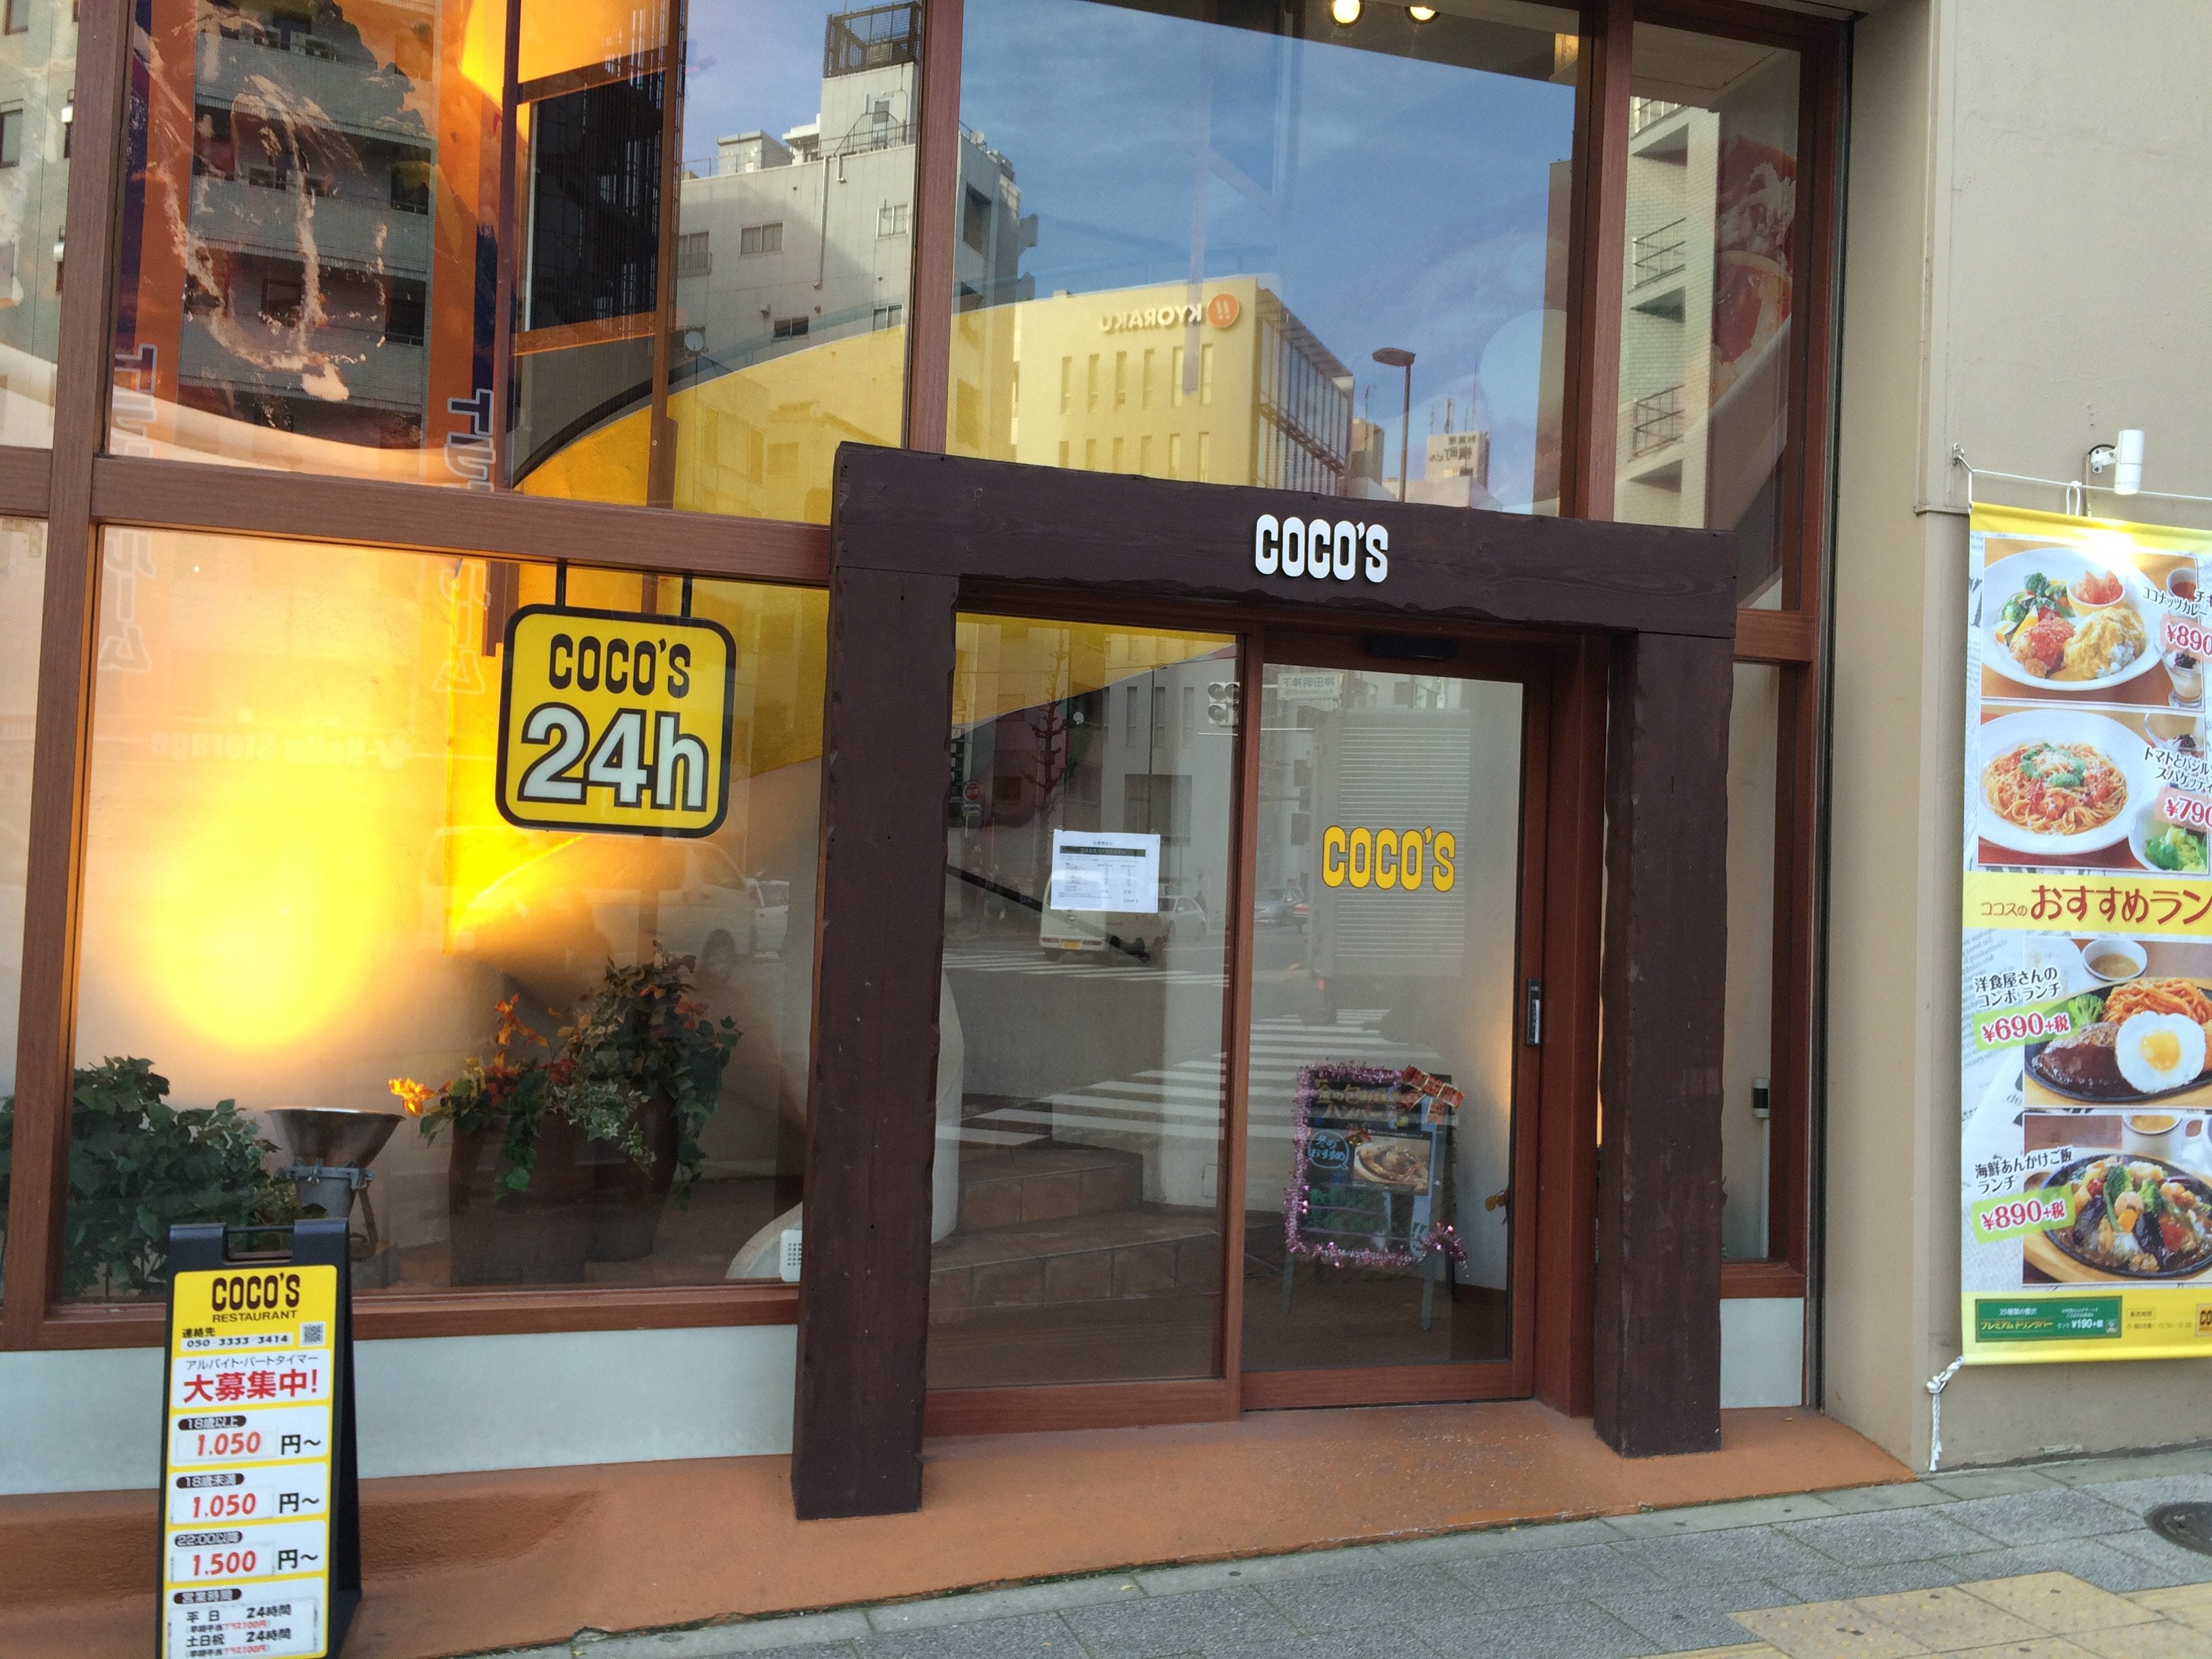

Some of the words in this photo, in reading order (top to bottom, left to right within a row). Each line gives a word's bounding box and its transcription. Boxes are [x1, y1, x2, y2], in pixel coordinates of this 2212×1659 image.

[1254, 514, 1389, 583] COCO'S
[2142, 586, 2207, 616] ココナッツカレー
[549, 634, 691, 699] COCO'S
[517, 701, 709, 812] 24h
[2144, 747, 2212, 776] トマトとバジル
[1322, 825, 1456, 892] COCO'S
[1974, 967, 2058, 993] 洋食屋さんの
[1974, 1146, 2072, 1179] 海鮮あんかけご飯
[1977, 1176, 2016, 1195] ランチ
[211, 1272, 300, 1311] COCO'S
[212, 1310, 298, 1323] RESTAURANT
[182, 1327, 216, 1338] 連絡先
[258, 1335, 289, 1344] 3414
[182, 1589, 233, 1604] 営業時間
[246, 1604, 292, 1619] 24時間
[246, 1629, 291, 1643] 24時間
